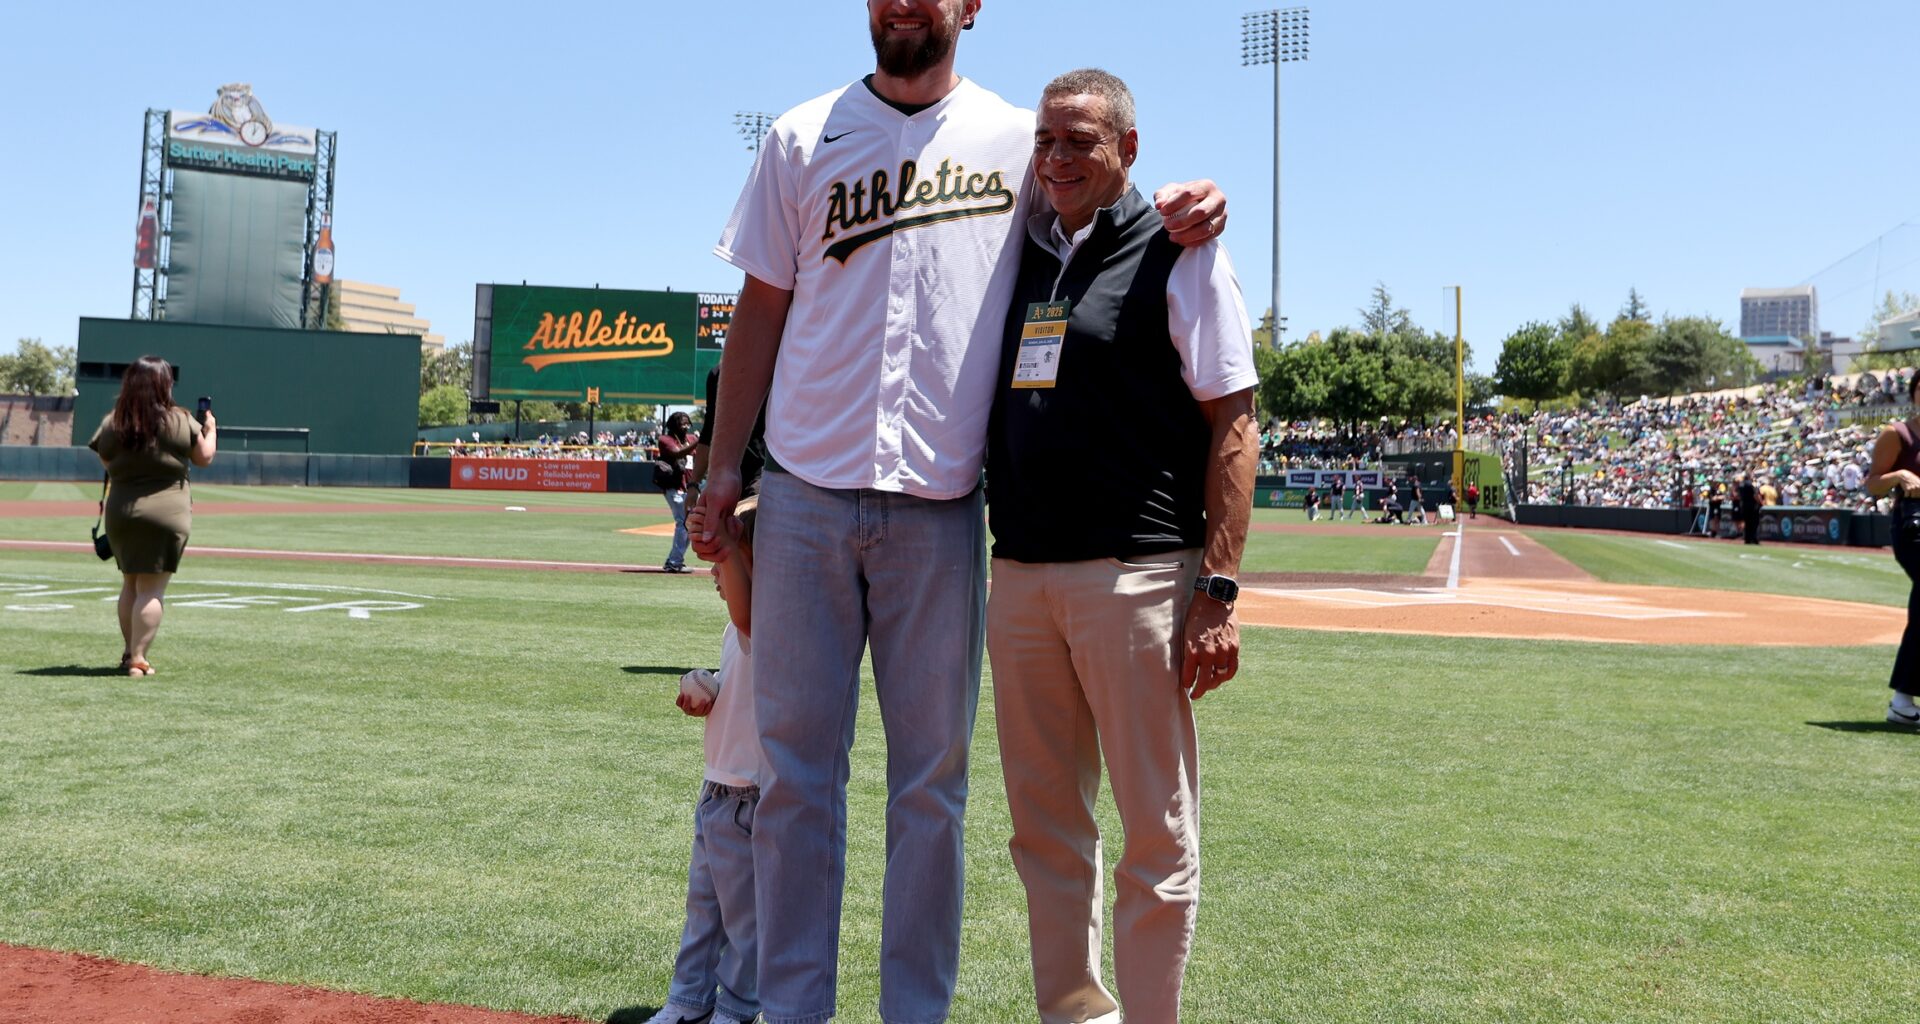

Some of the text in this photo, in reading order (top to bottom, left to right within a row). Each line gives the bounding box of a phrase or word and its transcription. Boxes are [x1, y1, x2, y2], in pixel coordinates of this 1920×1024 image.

[170, 143, 314, 173] Sutter Health Park
[822, 159, 1005, 244] Athletics
[698, 294, 738, 305] TODAY'S
[1046, 306, 1064, 318] 2025
[523, 309, 668, 351] Athletics
[1034, 326, 1055, 335] VISITOR
[543, 462, 580, 471] Low rates
[479, 466, 528, 481] SMUD
[543, 470, 601, 480] Reliable service
[543, 479, 592, 489] Clean energy
